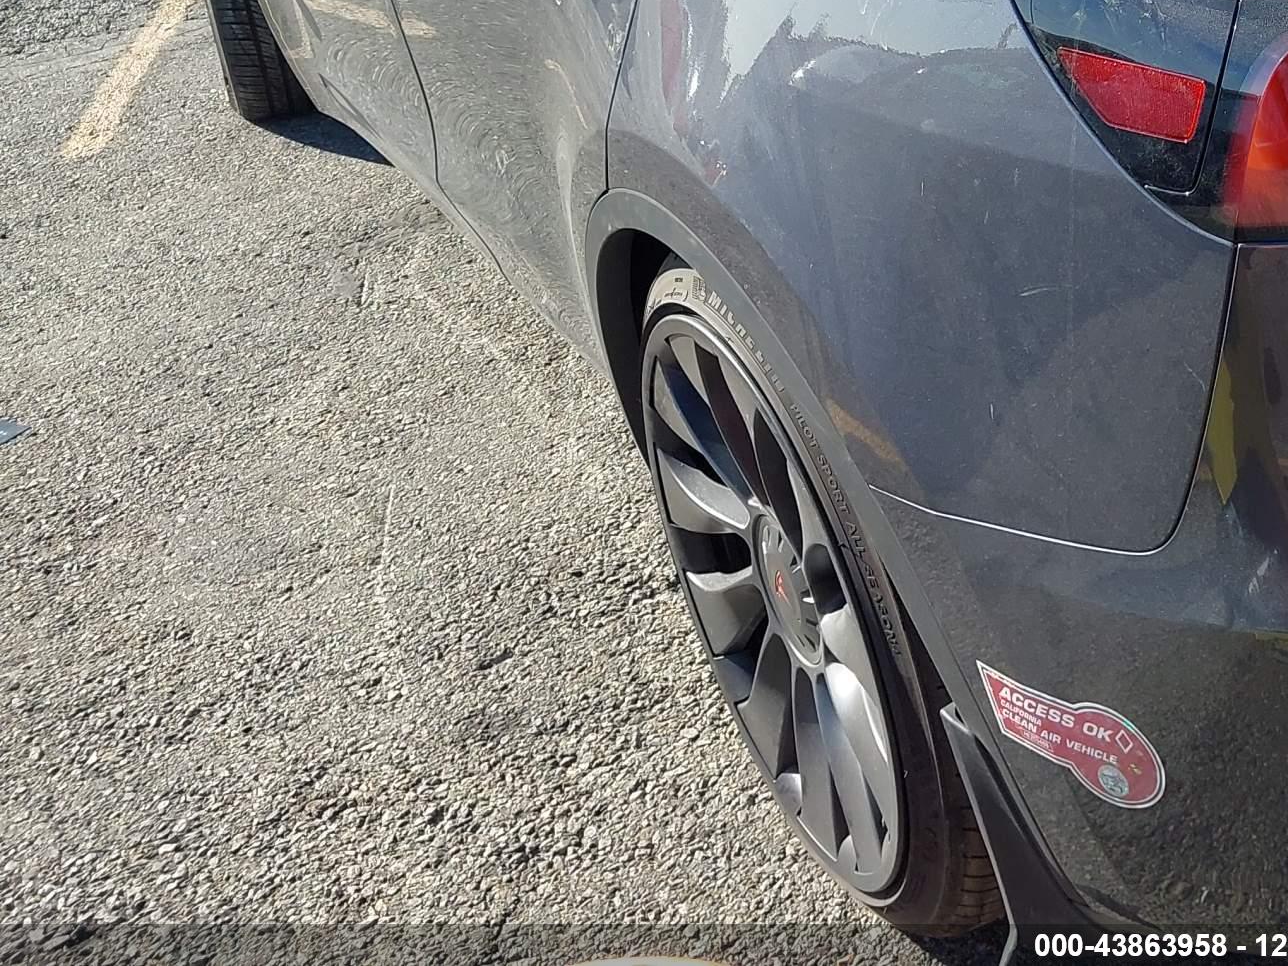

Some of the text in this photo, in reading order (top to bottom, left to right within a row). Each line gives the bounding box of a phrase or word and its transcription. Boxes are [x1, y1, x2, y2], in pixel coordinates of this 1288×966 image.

[790, 403, 818, 448] PILOT
[818, 454, 850, 514] SPORT
[846, 521, 868, 557] ALL
[999, 686, 1075, 727] ACCESS
[1083, 722, 1113, 742] OK
[1000, 699, 1042, 727] CALIFORNIA
[1002, 709, 1037, 733] CLEAN
[1040, 729, 1062, 744] AIR
[1066, 738, 1118, 764] VEHICLE
